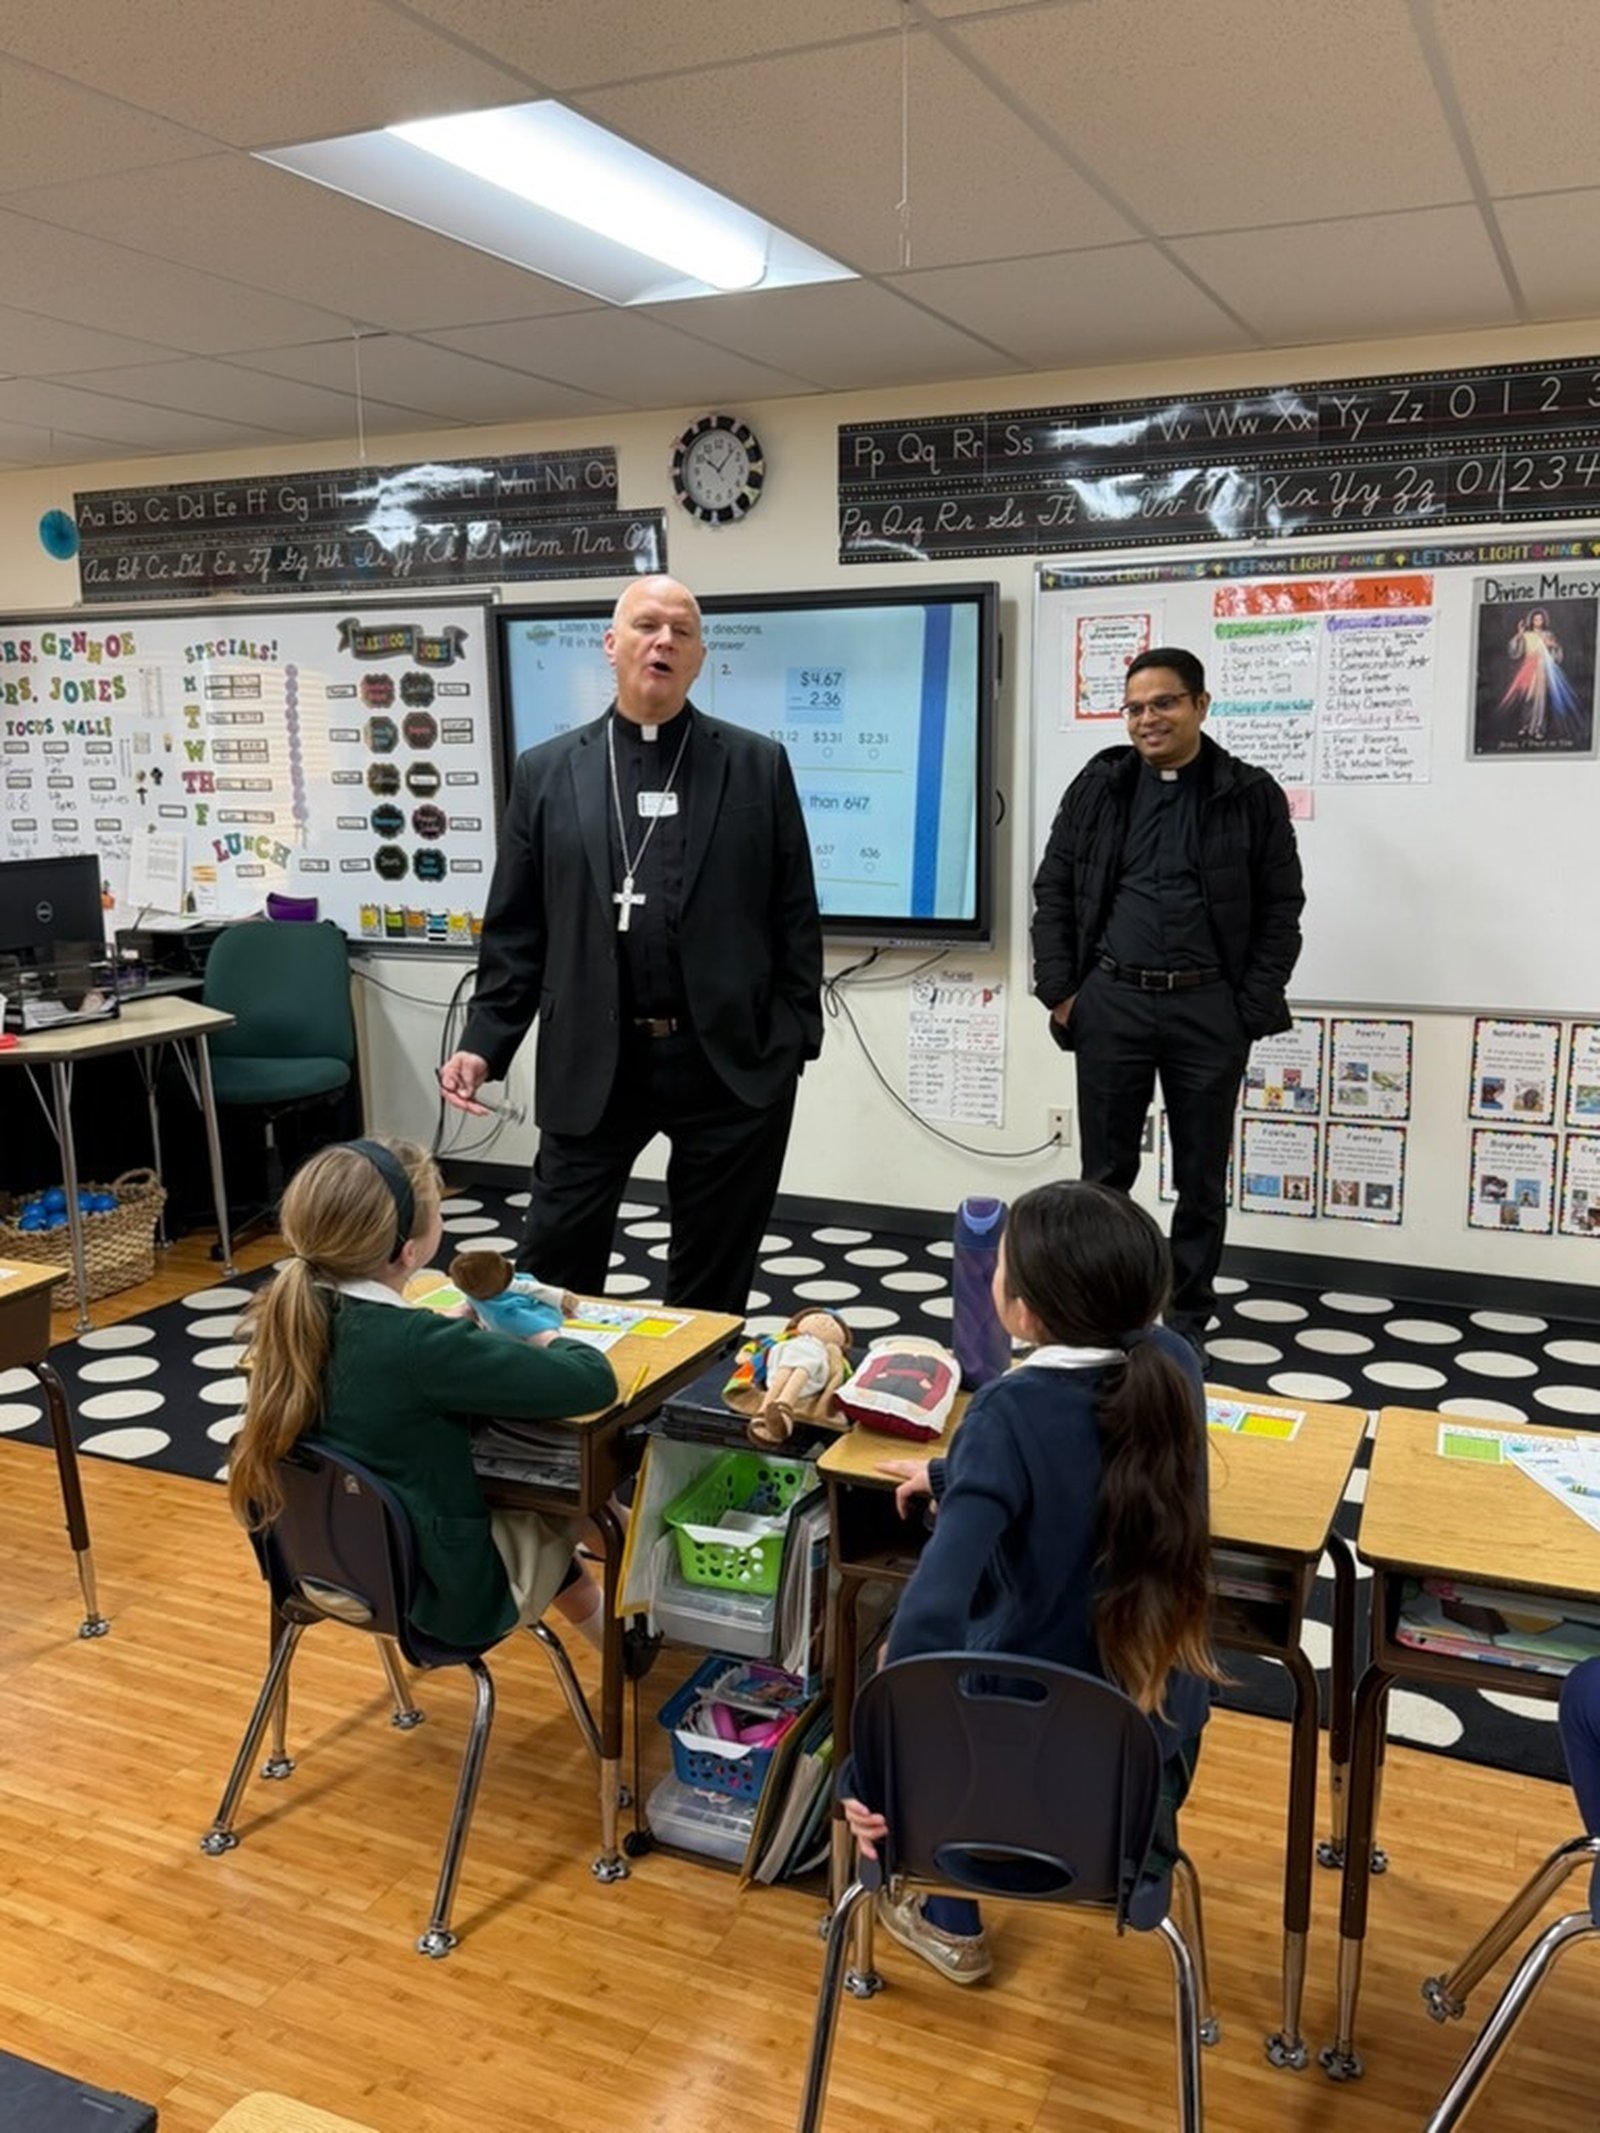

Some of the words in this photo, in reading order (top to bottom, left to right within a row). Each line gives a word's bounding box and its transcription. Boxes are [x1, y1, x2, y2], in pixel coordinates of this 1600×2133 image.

[855, 436, 885, 479] Pp
[898, 433, 940, 475] Qq
[953, 427, 983, 459] Rr
[1004, 424, 1034, 456] Ss
[1158, 409, 1191, 441] Vv
[1203, 404, 1260, 437] Ww
[1272, 398, 1313, 433] Xx
[1333, 395, 1370, 441] Yy
[1387, 390, 1425, 424] Zz
[1540, 376, 1562, 412] 2
[79, 506, 106, 526] Aa
[112, 500, 138, 525] Bb
[144, 497, 170, 522] Cc
[177, 495, 205, 520] Dd
[213, 492, 237, 518] Ee
[247, 488, 268, 513] Ff
[278, 486, 309, 522] Gg
[545, 464, 577, 493] Nn
[584, 459, 617, 489] Oo
[840, 507, 874, 539] Pp
[881, 505, 924, 545] Qq
[934, 501, 975, 533] Rr
[986, 496, 1026, 530] Ss
[1037, 493, 1079, 527] Tt
[1261, 475, 1320, 511] Xx
[1329, 471, 1383, 519] Yy
[1393, 465, 1437, 516] Zz
[1509, 457, 1534, 492] 2
[1539, 455, 1567, 491] 3
[1574, 452, 1600, 488] 4
[83, 559, 111, 584] Aa
[116, 553, 141, 582] Bb
[145, 553, 169, 581] Cc
[171, 552, 205, 580] Dd
[213, 550, 238, 577] Ee
[243, 548, 271, 584] Ff
[277, 546, 309, 582] Gg
[313, 543, 345, 570] Hh
[507, 530, 565, 559] Mm
[571, 525, 615, 555] Nn
[1228, 558, 1259, 575] LET
[1289, 554, 1338, 572] LIGHT
[1411, 549, 1444, 566] LET
[1477, 545, 1530, 562] LIGHT
[1115, 566, 1160, 584] LIGHT
[1483, 578, 1535, 603] Divine
[1539, 573, 1600, 600] Mercy
[0, 641, 38, 664] RS.
[183, 639, 278, 665] SPECIALS!
[0, 676, 38, 706] RS.
[49, 674, 127, 704] JONES
[183, 675, 198, 693] M
[800, 671, 843, 688] $4.67
[183, 704, 200, 730] T
[812, 731, 843, 744] $3.31
[857, 732, 890, 745] $2.31
[183, 739, 206, 763] W
[181, 770, 216, 794] TH
[195, 803, 210, 826] F
[809, 796, 840, 810] than
[842, 797, 871, 811] 647
[212, 832, 292, 870] LUNCH
[815, 844, 836, 856] 637
[859, 847, 881, 860] 636
[1355, 1028, 1386, 1040] Poetry
[1346, 1132, 1383, 1146] Fantasy
[1489, 1138, 1538, 1152] Biography
